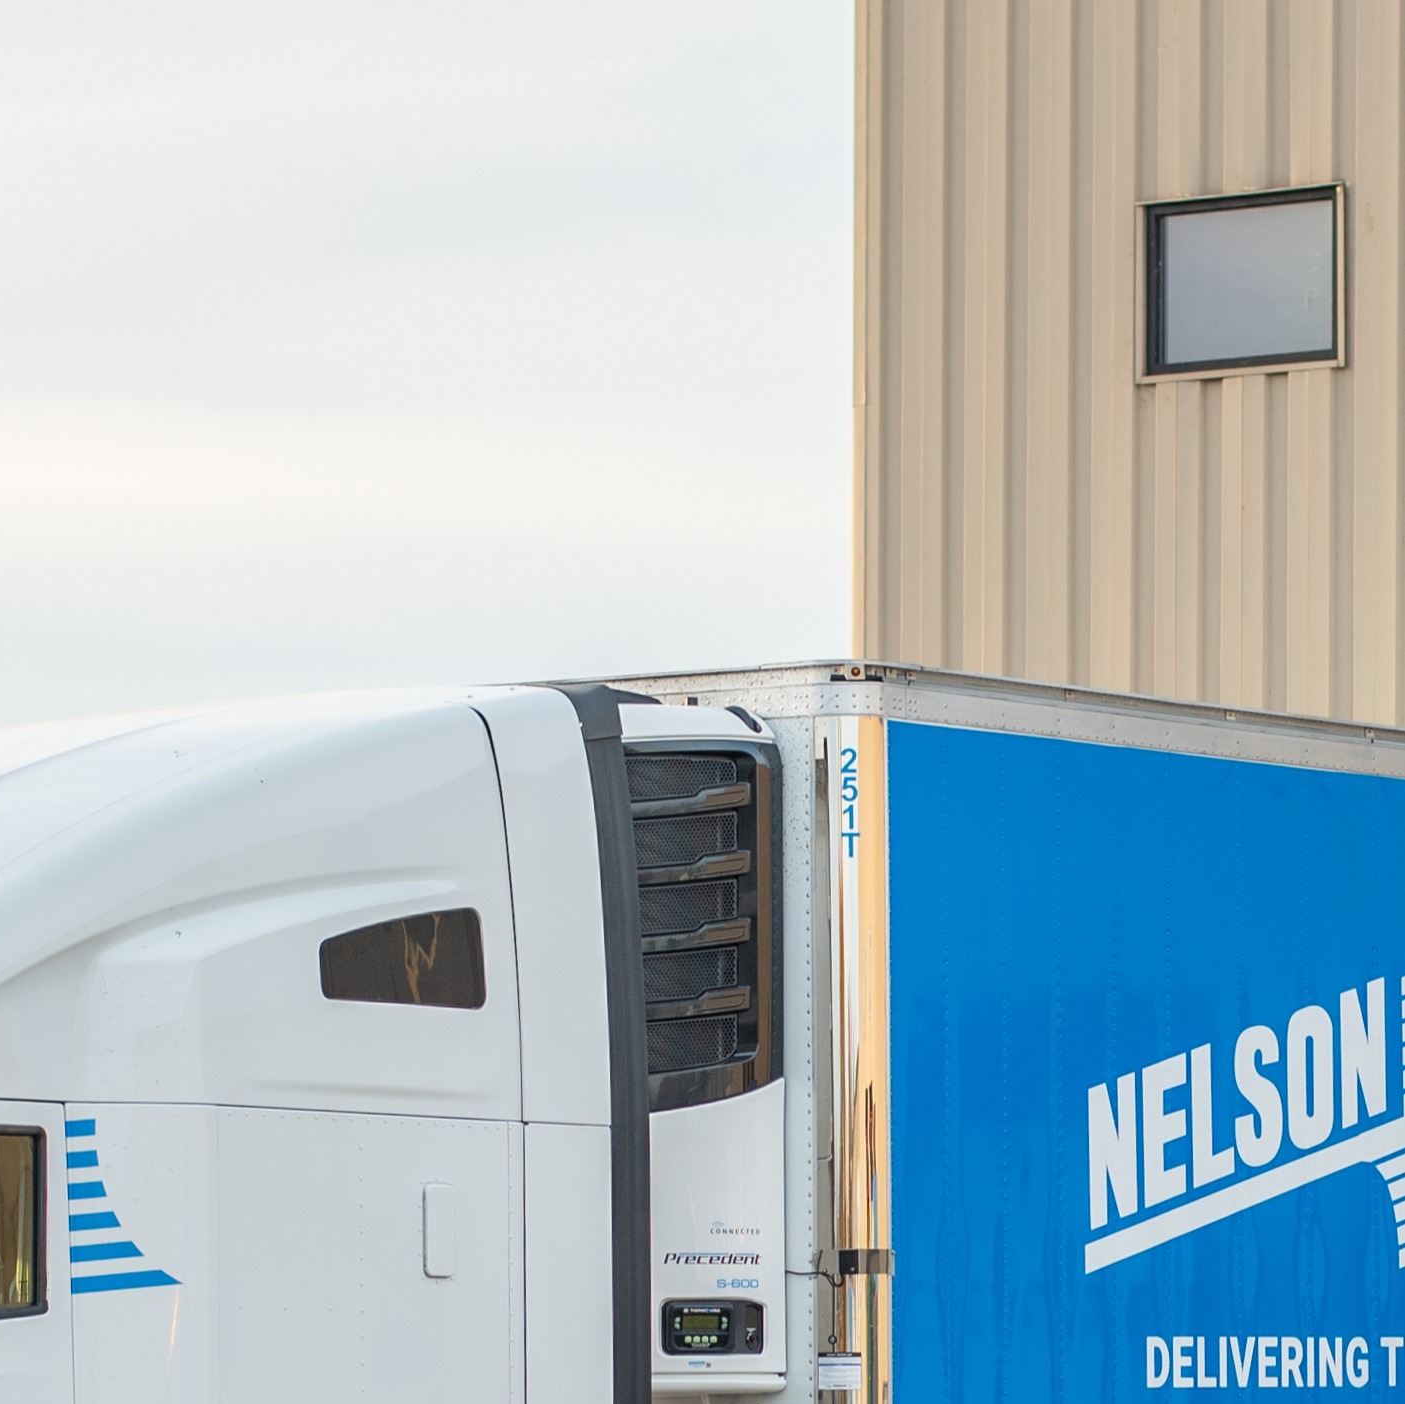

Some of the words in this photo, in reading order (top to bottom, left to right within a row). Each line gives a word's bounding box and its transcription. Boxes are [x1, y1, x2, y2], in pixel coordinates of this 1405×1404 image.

[840, 748, 860, 858] 251T
[1088, 976, 1387, 1231] NELSON
[663, 1252, 762, 1265] Precedent
[716, 1278, 759, 1289] S-600
[1146, 1336, 1369, 1389] DELIVERING
